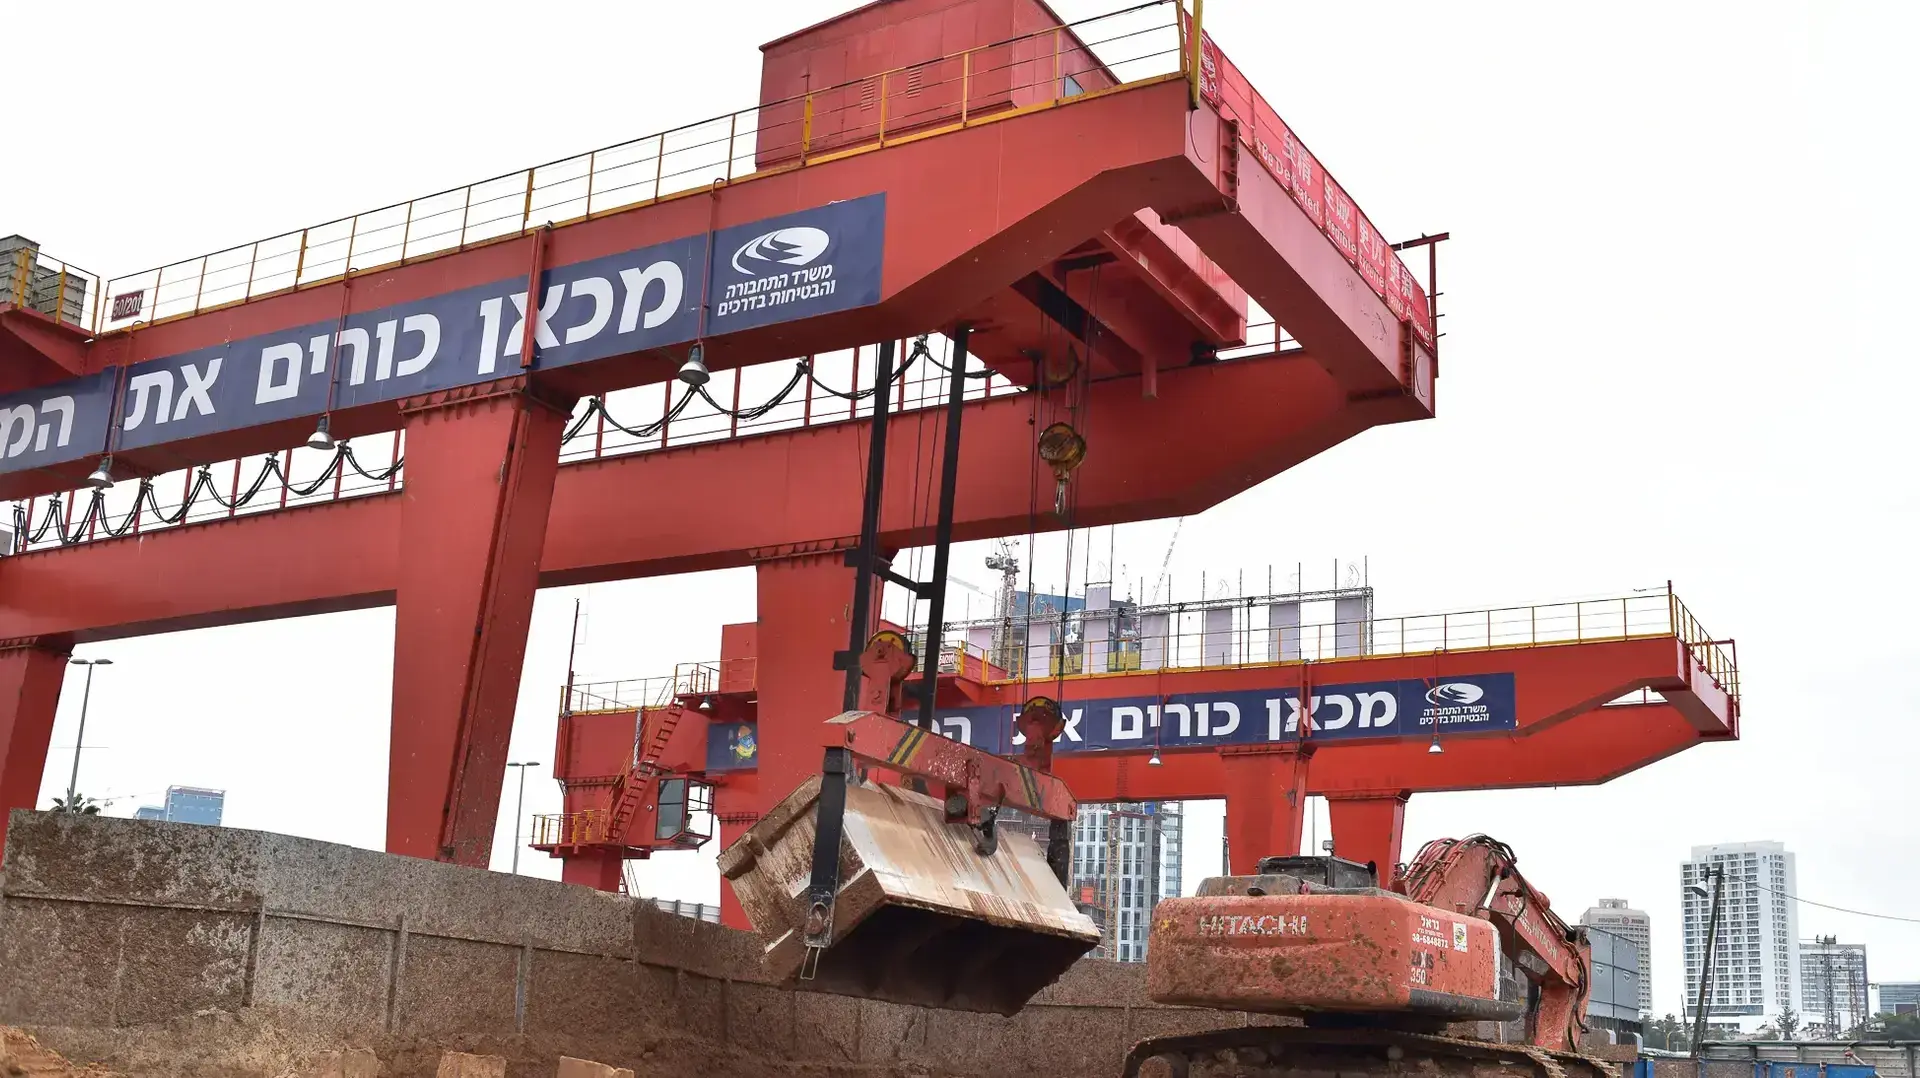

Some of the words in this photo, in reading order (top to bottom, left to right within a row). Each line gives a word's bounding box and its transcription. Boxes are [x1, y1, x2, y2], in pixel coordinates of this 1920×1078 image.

[725, 273, 788, 299] התחבורה
[791, 264, 833, 285] משרד
[717, 295, 766, 317] בדרכים
[769, 279, 836, 307] והבטיחות
[477, 261, 683, 376] מכאן
[255, 313, 441, 405] כורים
[124, 358, 223, 431] את
[1111, 701, 1241, 740] כורים
[1265, 690, 1397, 741] מכאן
[1450, 712, 1490, 724] והבטיחות
[1462, 704, 1487, 715] משרד
[1199, 914, 1307, 936] HITACHI
